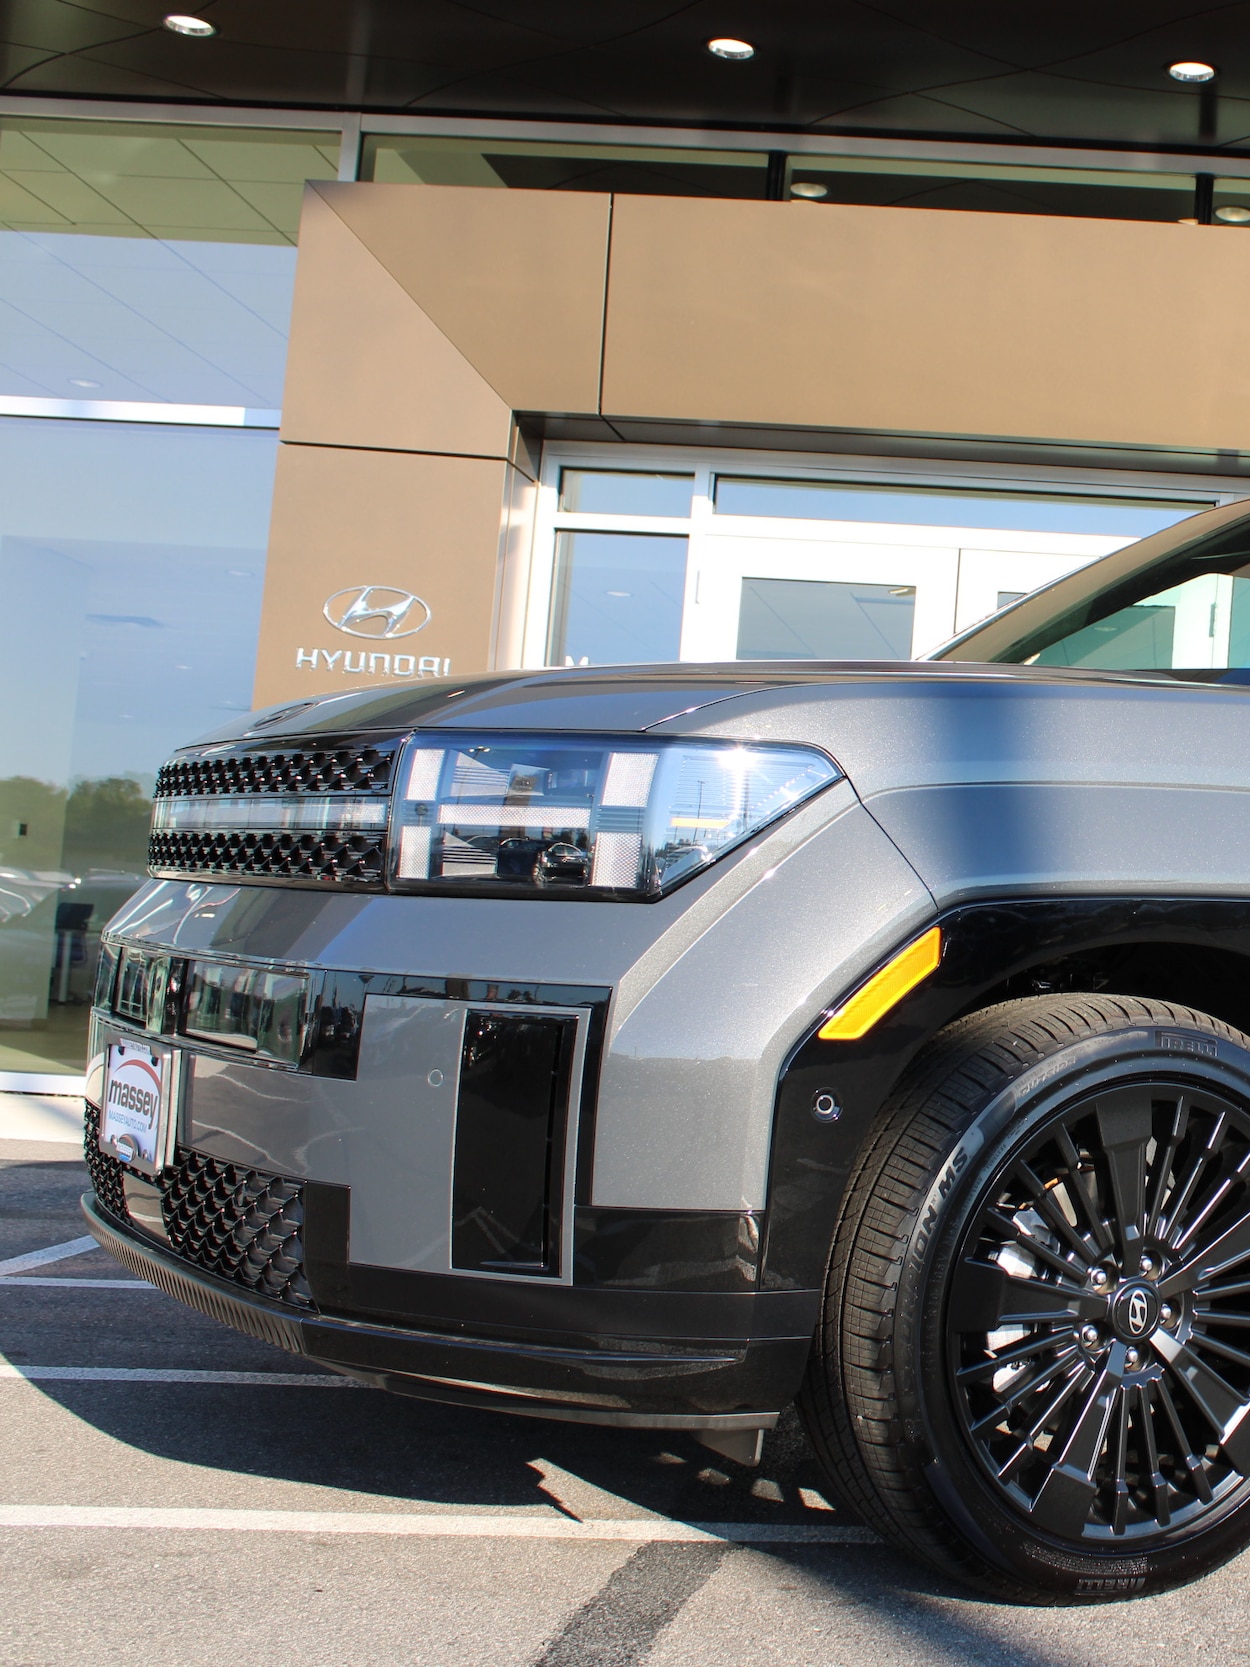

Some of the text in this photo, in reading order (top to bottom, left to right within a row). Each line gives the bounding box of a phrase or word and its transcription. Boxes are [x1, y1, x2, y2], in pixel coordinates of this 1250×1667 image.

[295, 647, 452, 677] HYUNDAI
[1160, 1031, 1218, 1057] PIRELLI
[108, 1078, 159, 1130] massey
[937, 1146, 968, 1201] MS
